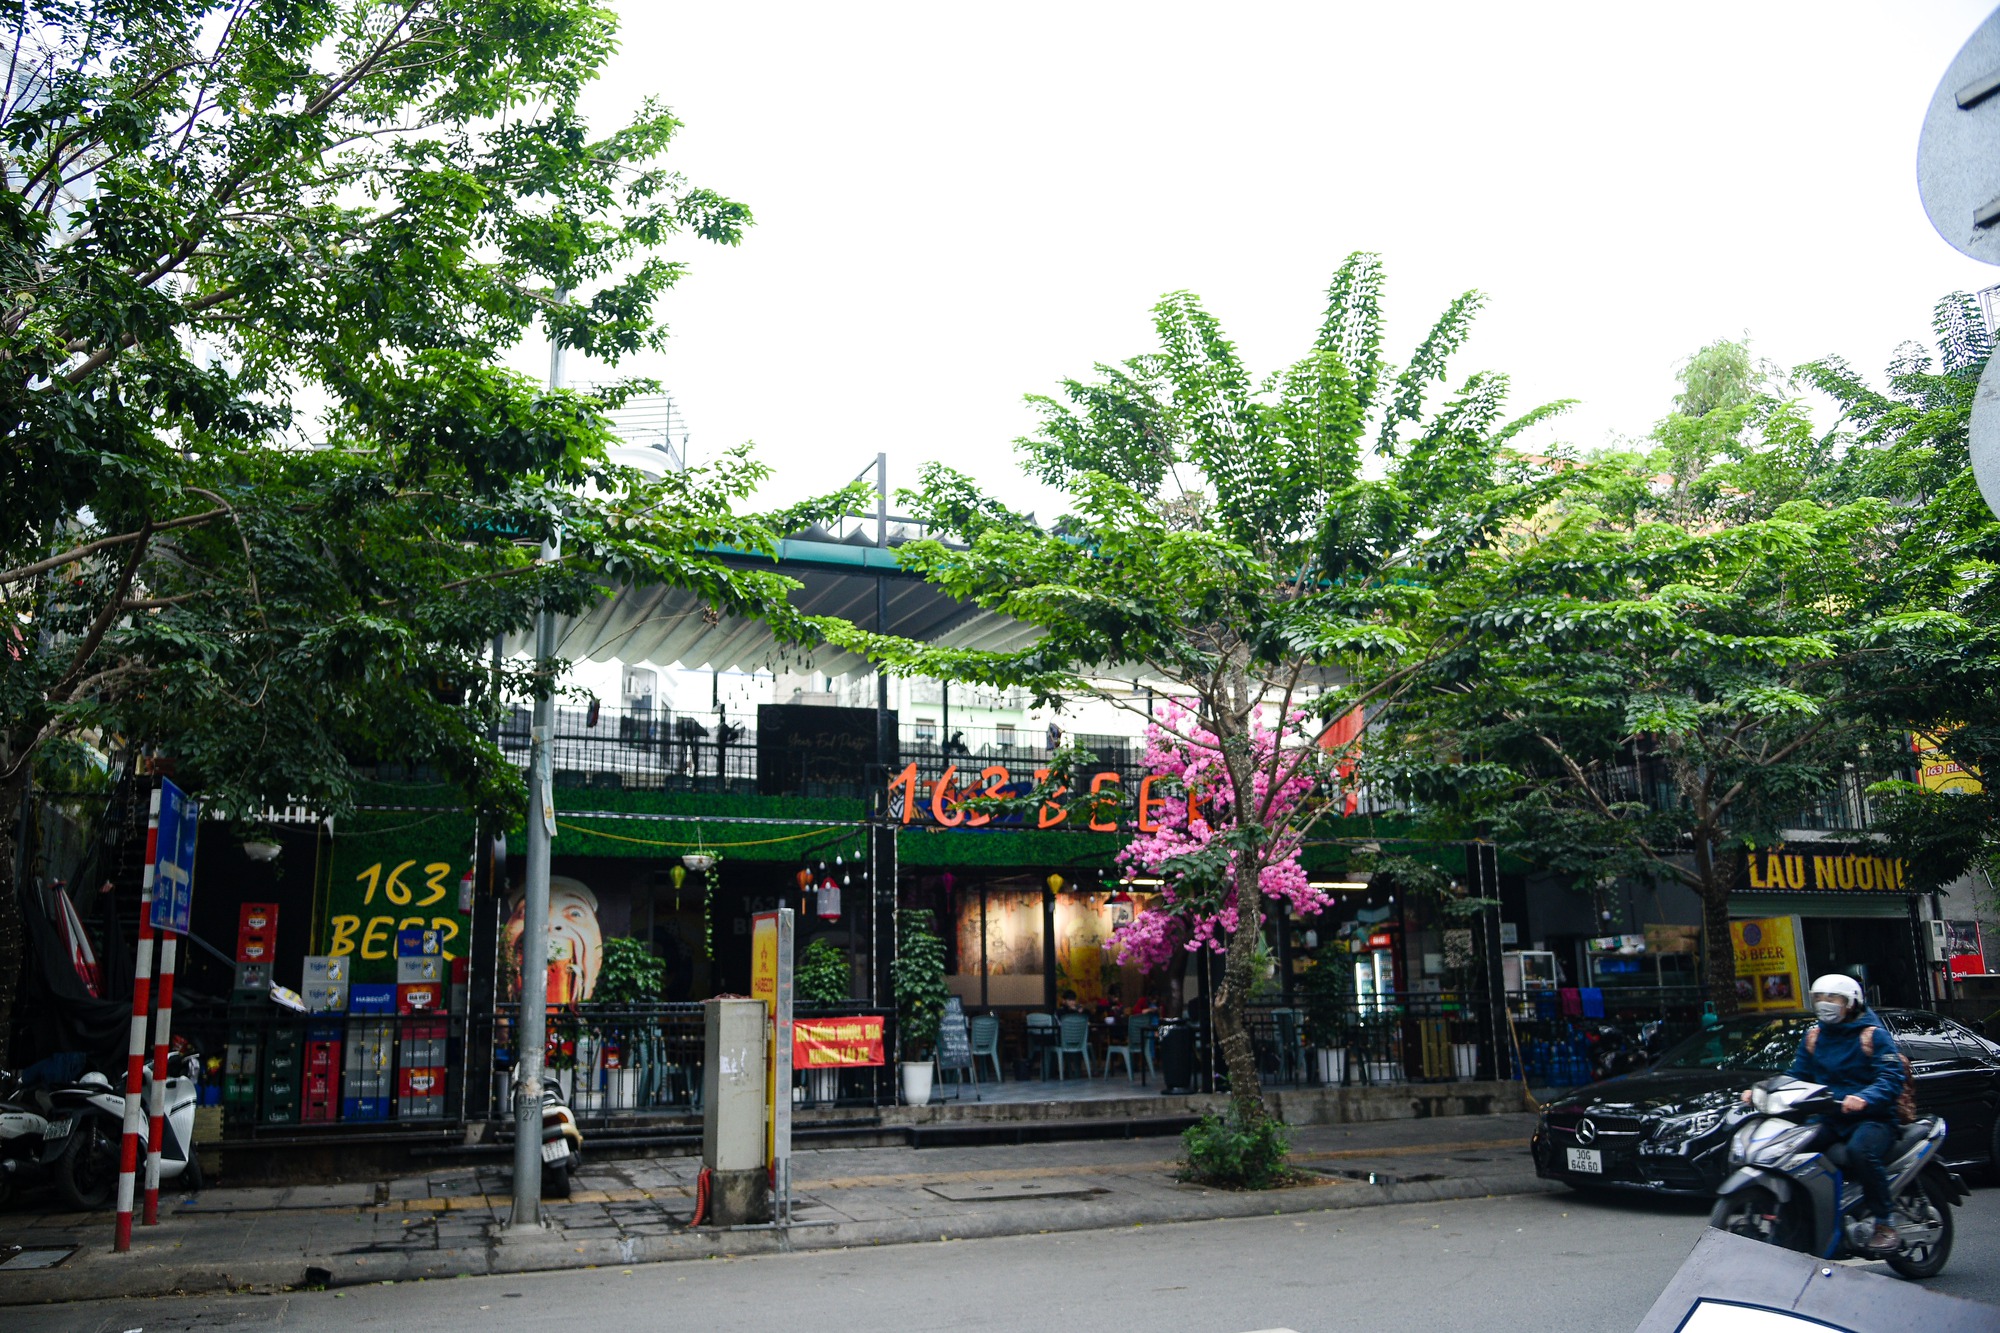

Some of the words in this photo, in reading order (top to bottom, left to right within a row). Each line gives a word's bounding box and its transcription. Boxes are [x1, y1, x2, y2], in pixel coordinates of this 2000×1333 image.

[1926, 765, 1943, 776] 163
[888, 762, 1010, 828] 163
[356, 859, 451, 907] 163
[1750, 946, 1785, 961] BEER
[865, 1024, 881, 1040] BIA
[857, 1047, 870, 1062] XE
[1576, 1150, 1591, 1160] 30G
